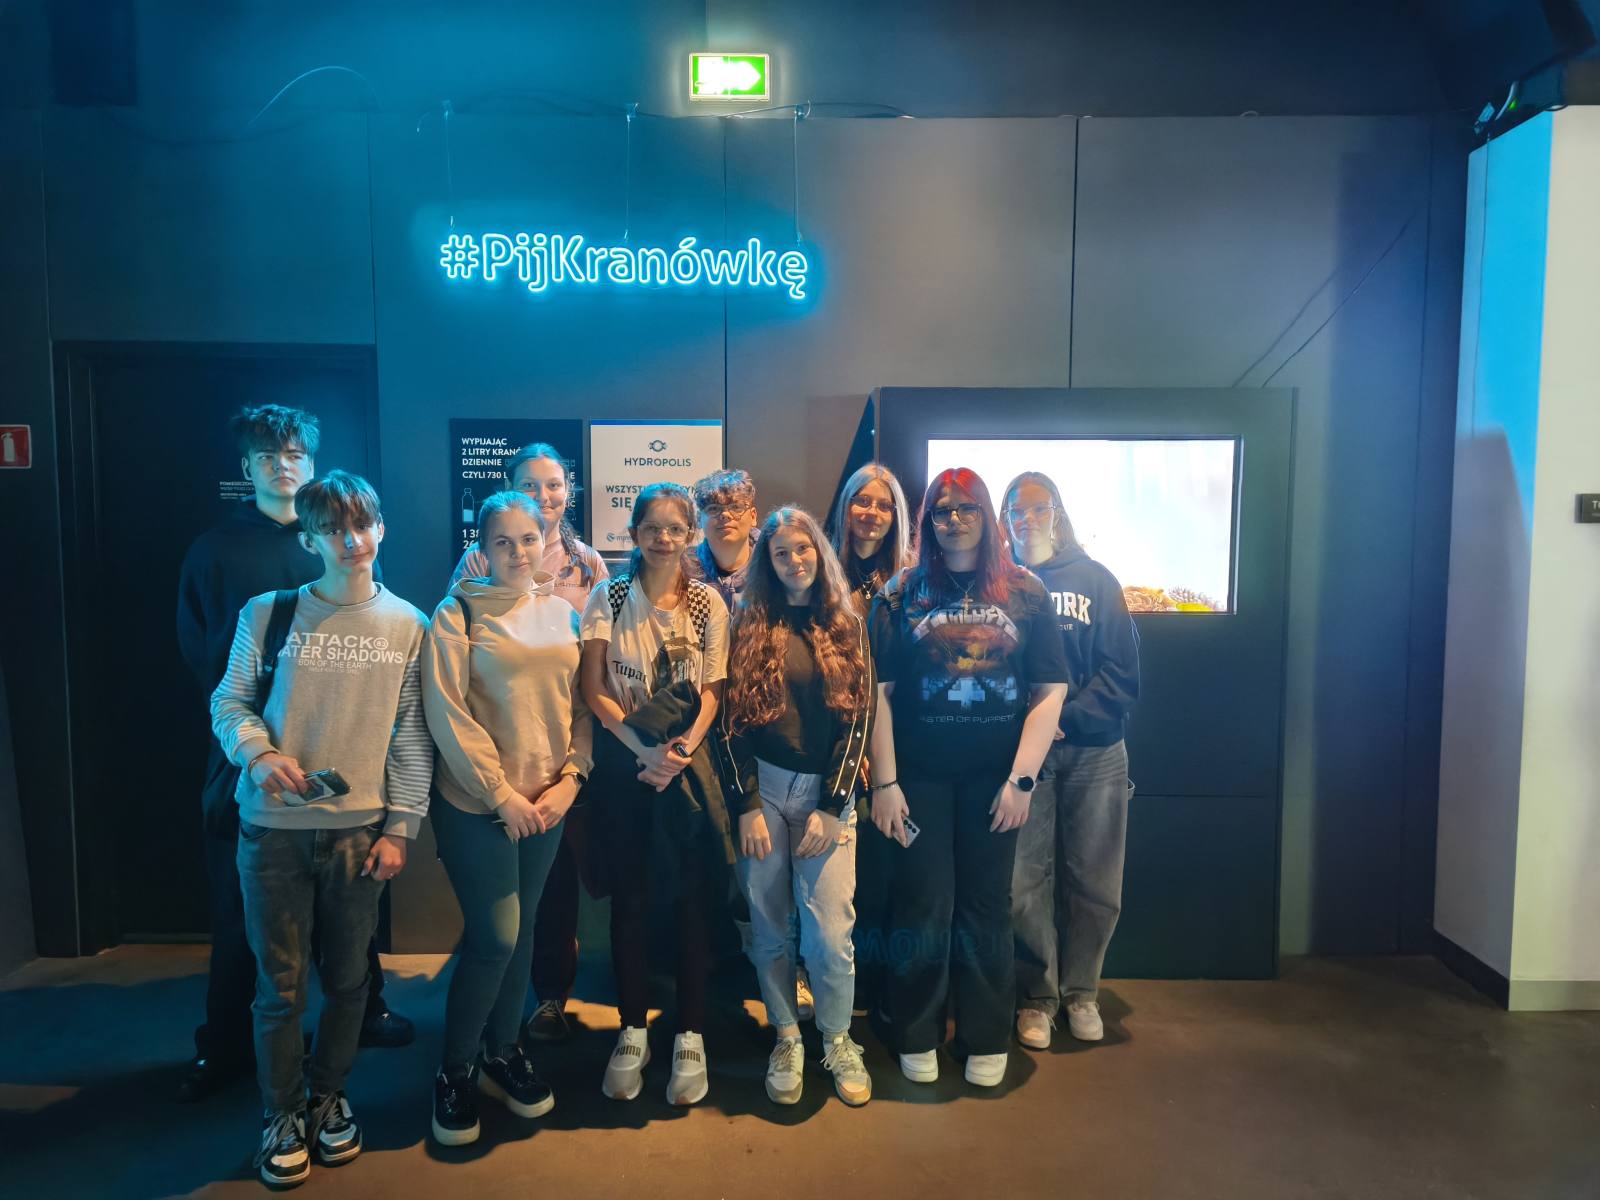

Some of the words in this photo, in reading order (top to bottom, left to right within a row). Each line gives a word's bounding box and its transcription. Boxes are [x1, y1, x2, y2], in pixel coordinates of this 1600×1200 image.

[440, 232, 808, 299] #PijKranówkę
[461, 437, 508, 447] WYPIJAJĄC
[461, 448, 467, 456] 2
[468, 448, 491, 456] LITRY
[462, 458, 502, 466] DZIENNIE
[624, 457, 692, 467] HYDROPOLIS
[462, 471, 486, 479] CZYLI
[487, 471, 502, 479] 730
[611, 497, 633, 511] SIĘ
[286, 631, 373, 650] ATTACK
[277, 645, 322, 659] ATER
[326, 647, 404, 664] SHADOWS
[330, 661, 344, 669] THE
[346, 661, 372, 670] EARTH
[615, 1045, 642, 1059] PUMA
[675, 1049, 701, 1063] PUMA
